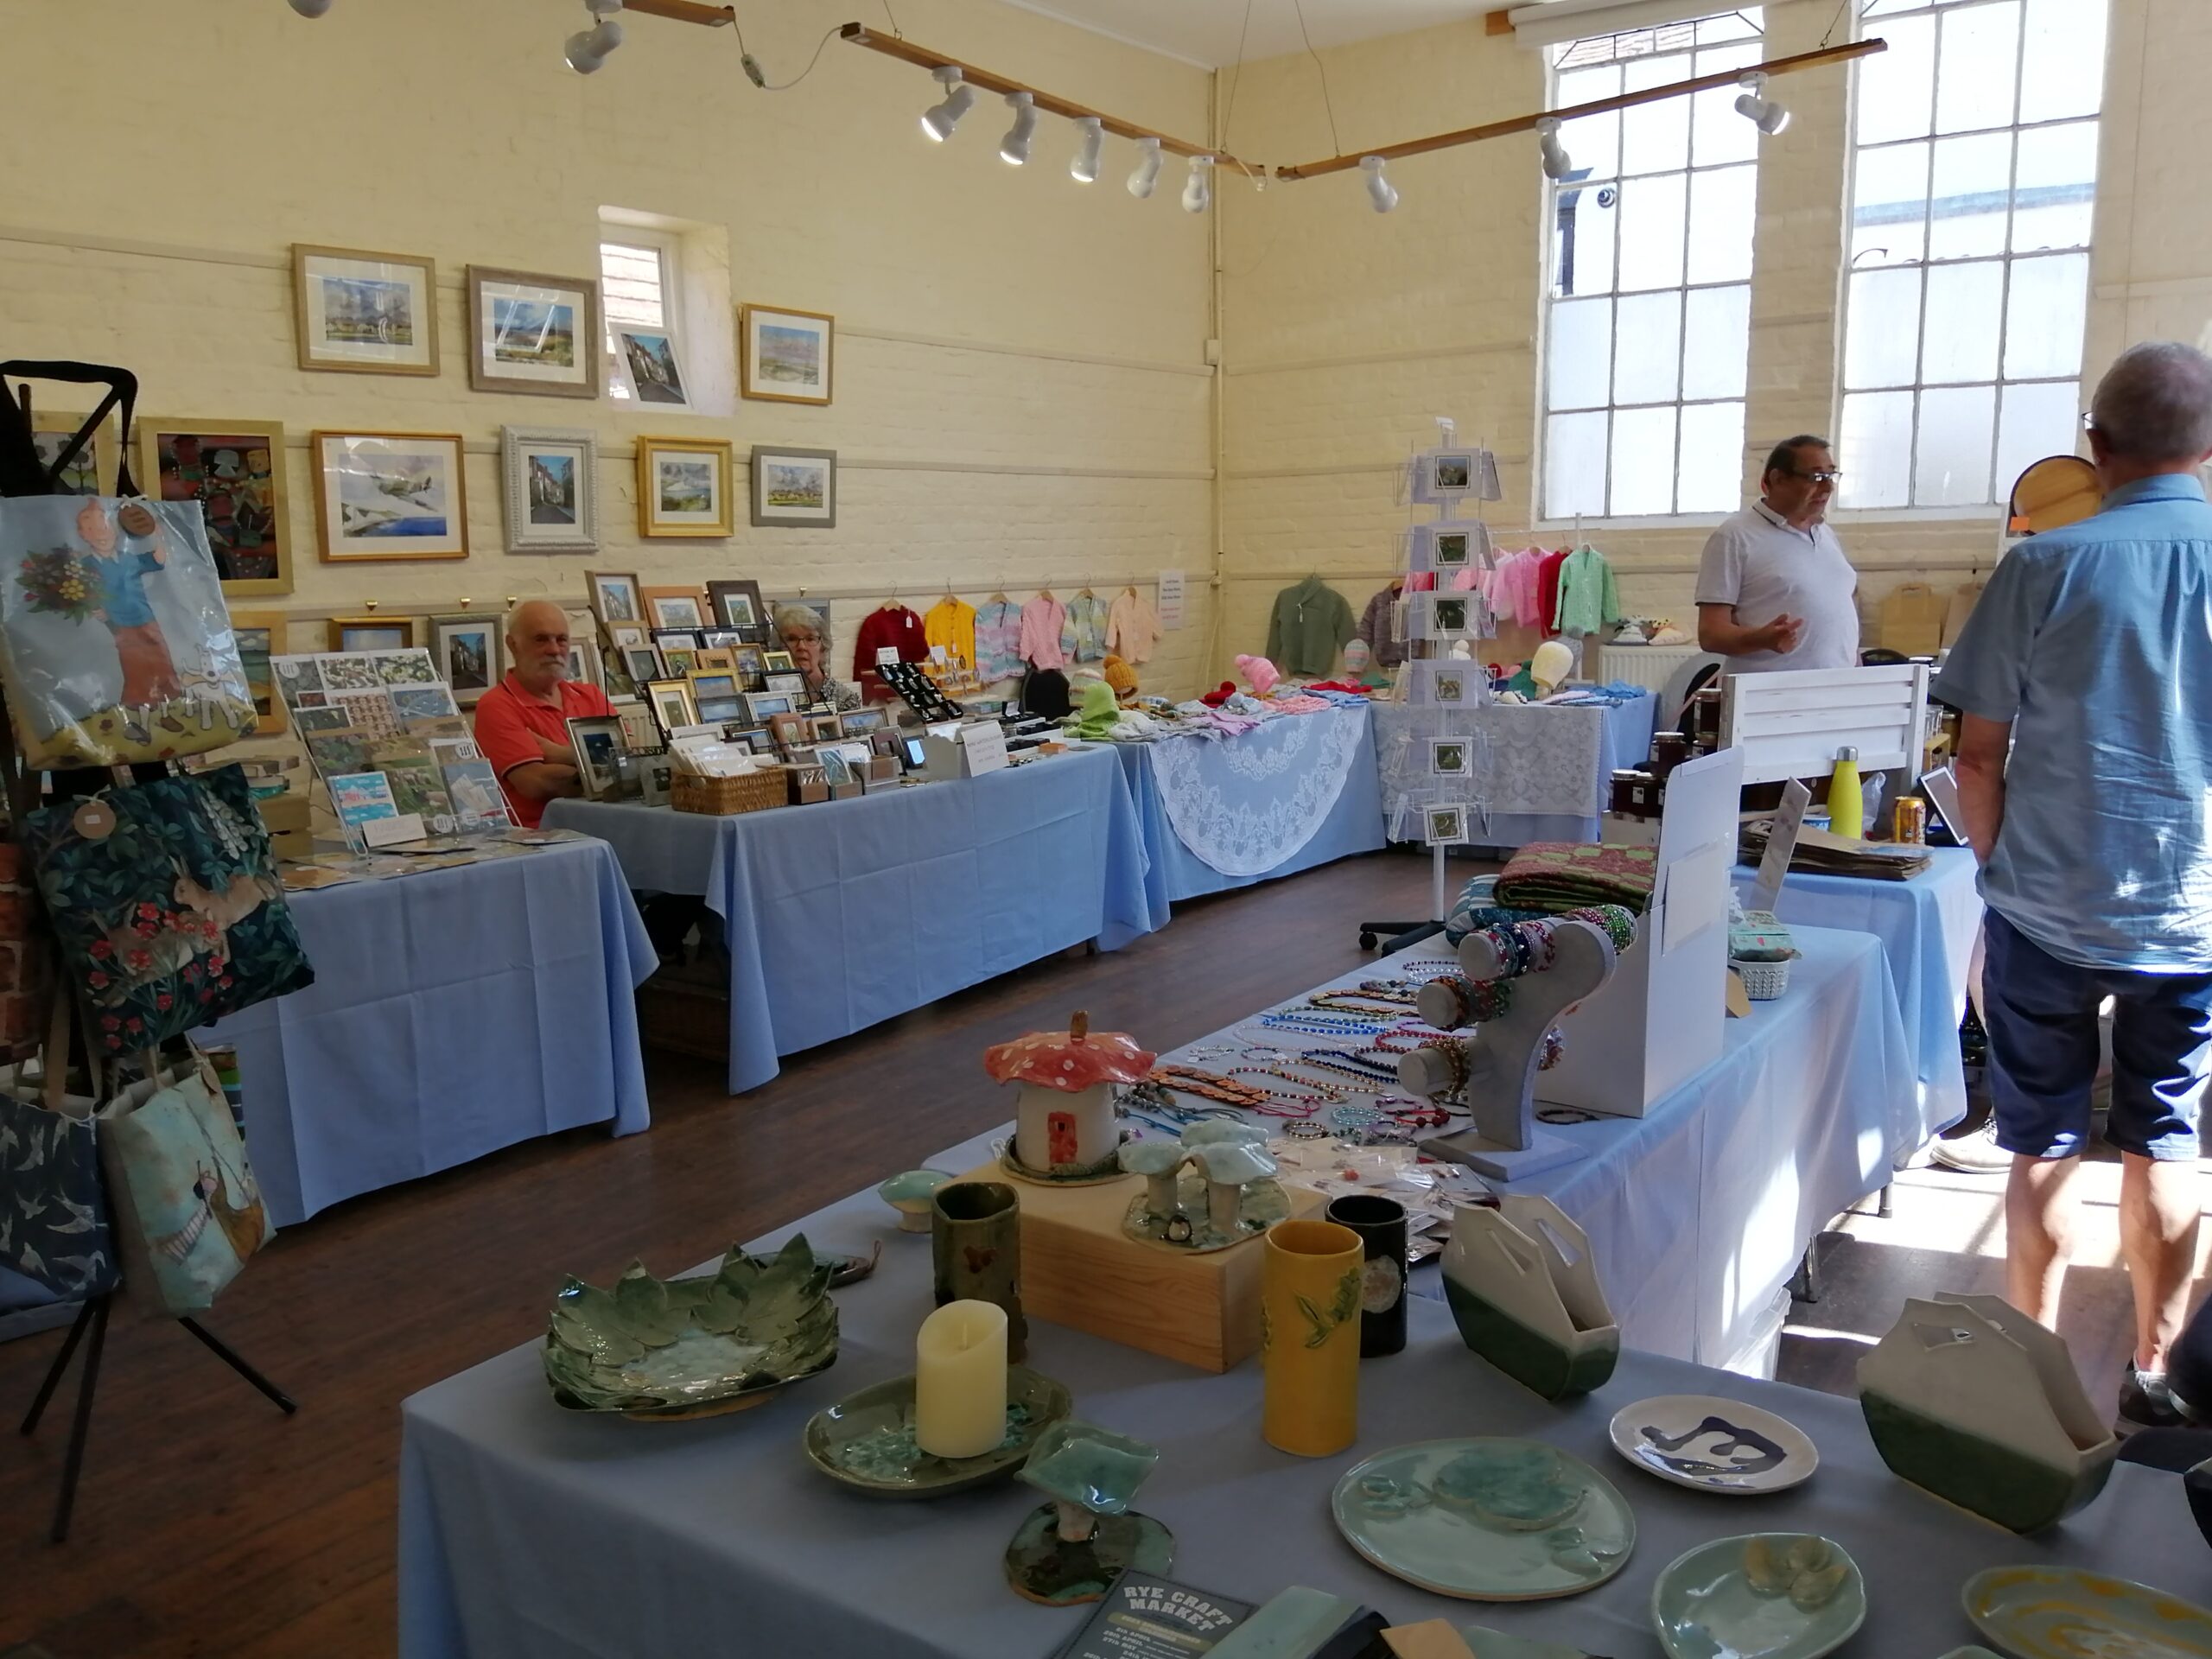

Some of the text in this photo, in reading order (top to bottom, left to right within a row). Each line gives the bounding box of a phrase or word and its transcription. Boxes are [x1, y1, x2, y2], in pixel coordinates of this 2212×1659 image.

[1123, 1586, 1165, 1599] RYE
[1171, 1591, 1233, 1625] CRAFT
[1129, 1598, 1216, 1631] MARKET
